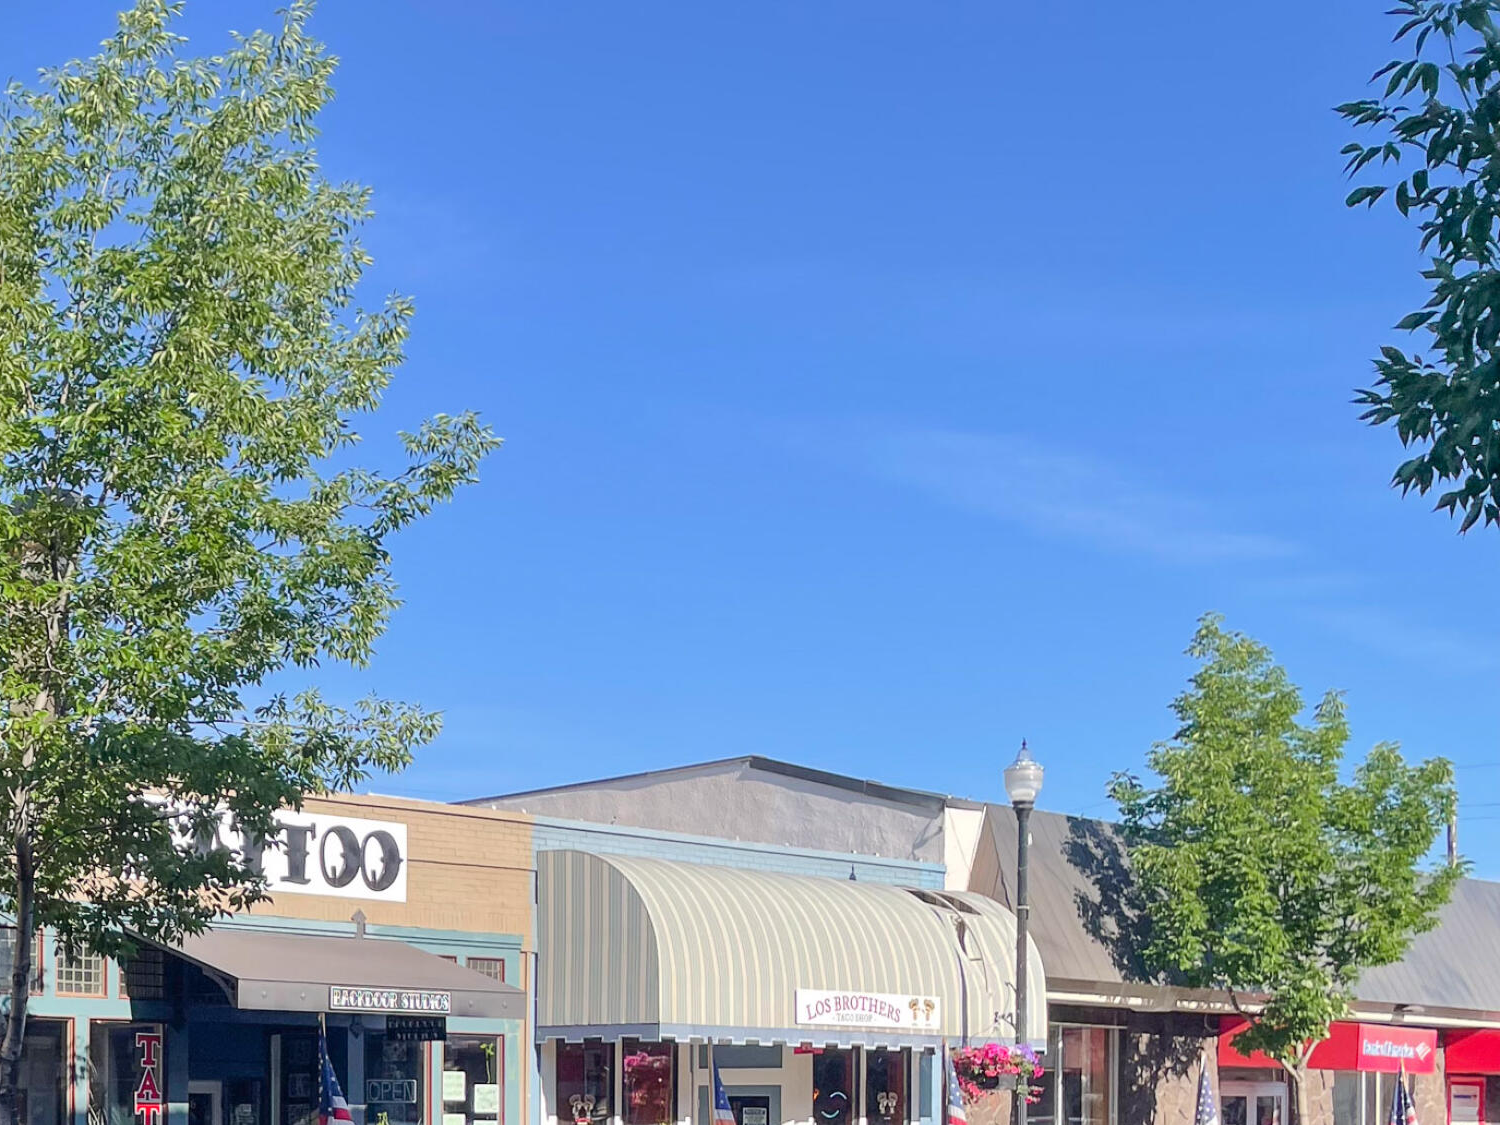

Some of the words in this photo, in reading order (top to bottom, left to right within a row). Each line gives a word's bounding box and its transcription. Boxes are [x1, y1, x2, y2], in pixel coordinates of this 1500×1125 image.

[333, 989, 398, 1009] BACKDOOR
[401, 992, 449, 1011] STUDIOS
[806, 998, 832, 1021] LOS
[834, 995, 901, 1024] BROTHERS
[369, 1081, 414, 1101] OPEN
